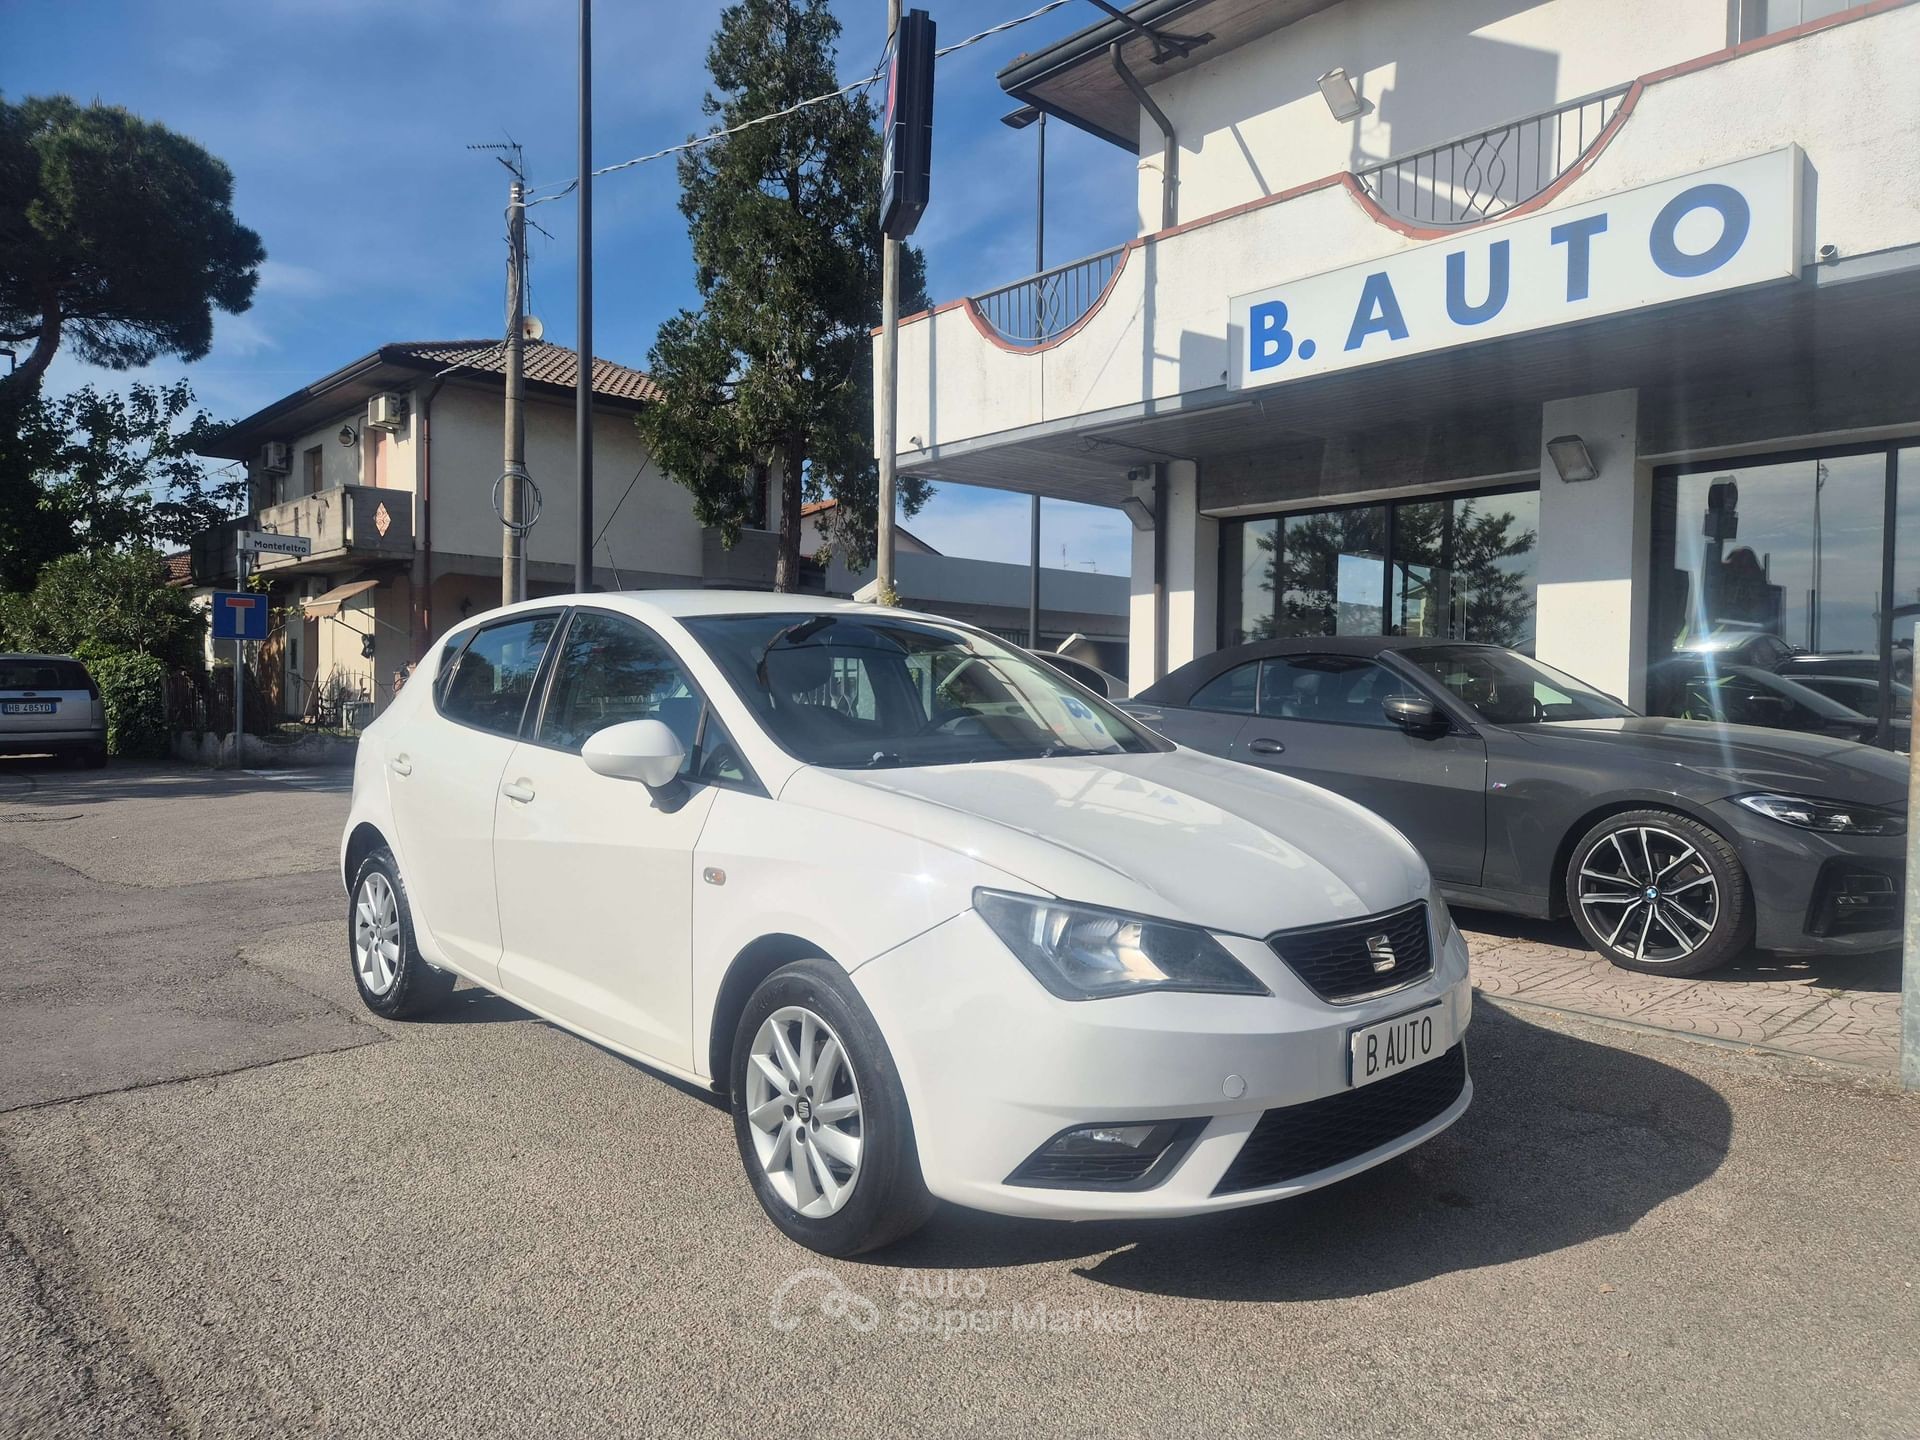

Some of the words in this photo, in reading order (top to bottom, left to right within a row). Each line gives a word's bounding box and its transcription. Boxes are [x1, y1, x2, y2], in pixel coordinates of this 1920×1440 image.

[1249, 299, 1317, 373] B.
[1343, 183, 1751, 352] AUTO
[254, 540, 307, 553] Montefeltro
